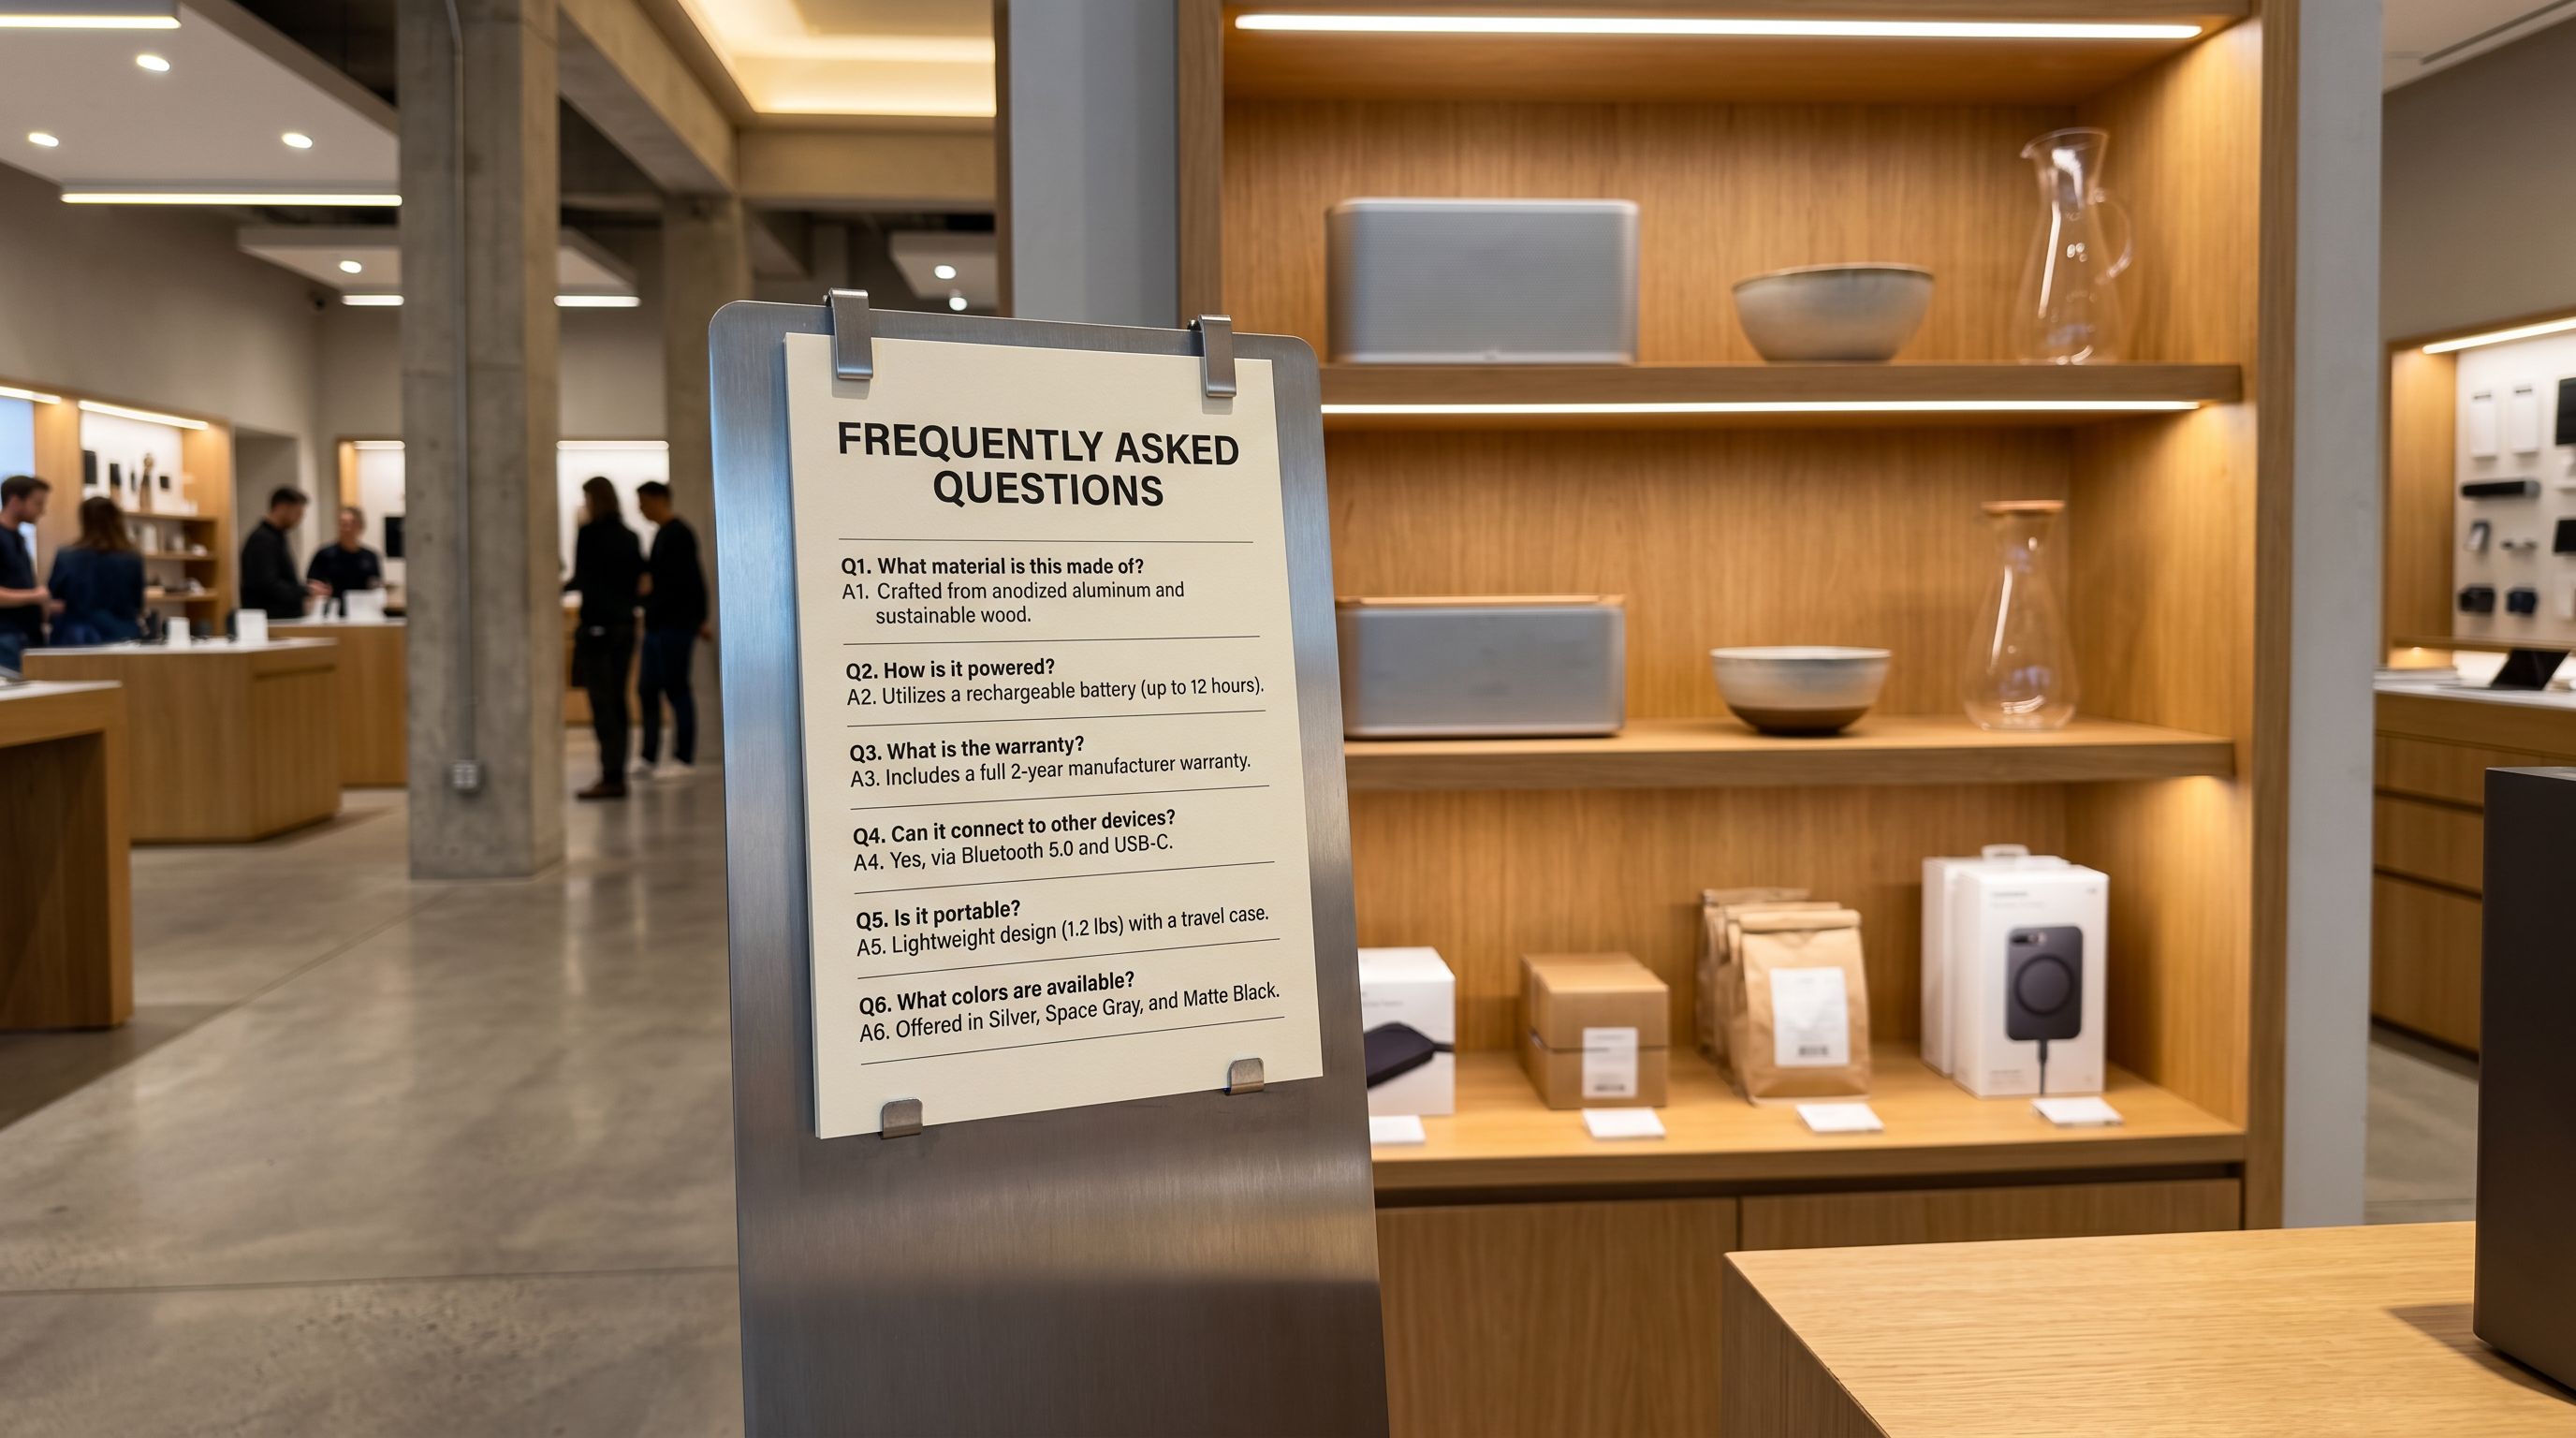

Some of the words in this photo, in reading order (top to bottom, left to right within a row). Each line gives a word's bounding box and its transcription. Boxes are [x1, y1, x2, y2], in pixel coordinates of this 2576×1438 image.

[838, 421, 1104, 463] FREQUENTLY
[1114, 432, 1239, 466] ASKED
[933, 469, 1164, 508] QUESTIONS
[841, 557, 871, 577] Q1.
[877, 556, 928, 575] What
[931, 557, 1006, 575] material
[1010, 557, 1026, 575] is
[1029, 557, 1062, 575] this
[1066, 557, 1114, 575] made
[1118, 557, 1145, 575] of?
[842, 582, 870, 600] A1.
[877, 581, 943, 600] Crafted
[946, 581, 988, 599] from
[991, 580, 1067, 599] anodized
[1072, 580, 1151, 599] aluminum
[1155, 580, 1185, 598] and
[875, 605, 976, 624] sustainable
[980, 605, 1032, 624] wood.
[845, 662, 879, 682] Q2.
[884, 662, 926, 680] How
[930, 660, 946, 678] is
[950, 659, 963, 678] it
[967, 657, 1055, 682] powered?
[846, 688, 877, 706] A2.
[882, 685, 946, 705] Utilizes
[950, 688, 961, 703] a
[966, 681, 1076, 705] rechargeable
[1079, 681, 1136, 701] battery
[1140, 679, 1167, 700] (up
[1170, 680, 1187, 696] to
[1190, 678, 1208, 695] 12
[1211, 676, 1265, 697] hours).
[849, 744, 883, 764] Q3.
[886, 741, 937, 760] What
[941, 740, 958, 758] is
[960, 739, 991, 757] the
[994, 735, 1085, 756] warranty?
[850, 770, 881, 788] A3.
[886, 765, 960, 786] Includes
[965, 769, 975, 783] a
[979, 762, 1006, 781] full
[1010, 762, 1064, 784] 2-year
[1068, 756, 1177, 777] manufacturer
[1179, 753, 1251, 772] warranty.
[853, 827, 886, 848] Q4.
[891, 825, 929, 844] Can
[933, 822, 946, 841] it
[950, 818, 1025, 840] connect
[1027, 817, 1046, 834] to
[1050, 814, 1097, 833] other
[1101, 808, 1176, 829] devices?
[853, 853, 885, 873] A4.
[889, 851, 927, 871] Yes,
[930, 847, 957, 866] via
[961, 841, 1044, 864] Bluetooth
[1048, 840, 1074, 858] 5.0
[1078, 836, 1109, 856] and
[1114, 832, 1173, 854] USB-C.
[856, 911, 888, 932] Q5.
[894, 908, 911, 927] Is
[915, 906, 929, 925] it
[933, 899, 1021, 929] portable?
[856, 937, 886, 958] A5.
[892, 927, 996, 957] Lightweight
[1000, 922, 1057, 946] design
[1061, 919, 1090, 942] (1.2
[1093, 915, 1124, 937] lbs)
[1128, 912, 1163, 932] with
[1167, 915, 1178, 929] a
[1180, 906, 1224, 928] travel
[1229, 907, 1269, 923] case.
[858, 995, 892, 1018] Q6.
[896, 990, 947, 1011] What
[951, 985, 1009, 1006] colors
[1013, 983, 1043, 1000] are
[1046, 970, 1134, 996] available?
[859, 1022, 890, 1043] A6.
[895, 1013, 962, 1038] Offered
[968, 1012, 984, 1031] in
[988, 1007, 1041, 1029] Silver,
[1046, 1004, 1098, 1026] Space
[1102, 998, 1144, 1018] Gray,
[1149, 990, 1178, 1011] and
[1183, 988, 1229, 1007] Matte
[1233, 981, 1281, 1003] Black.
